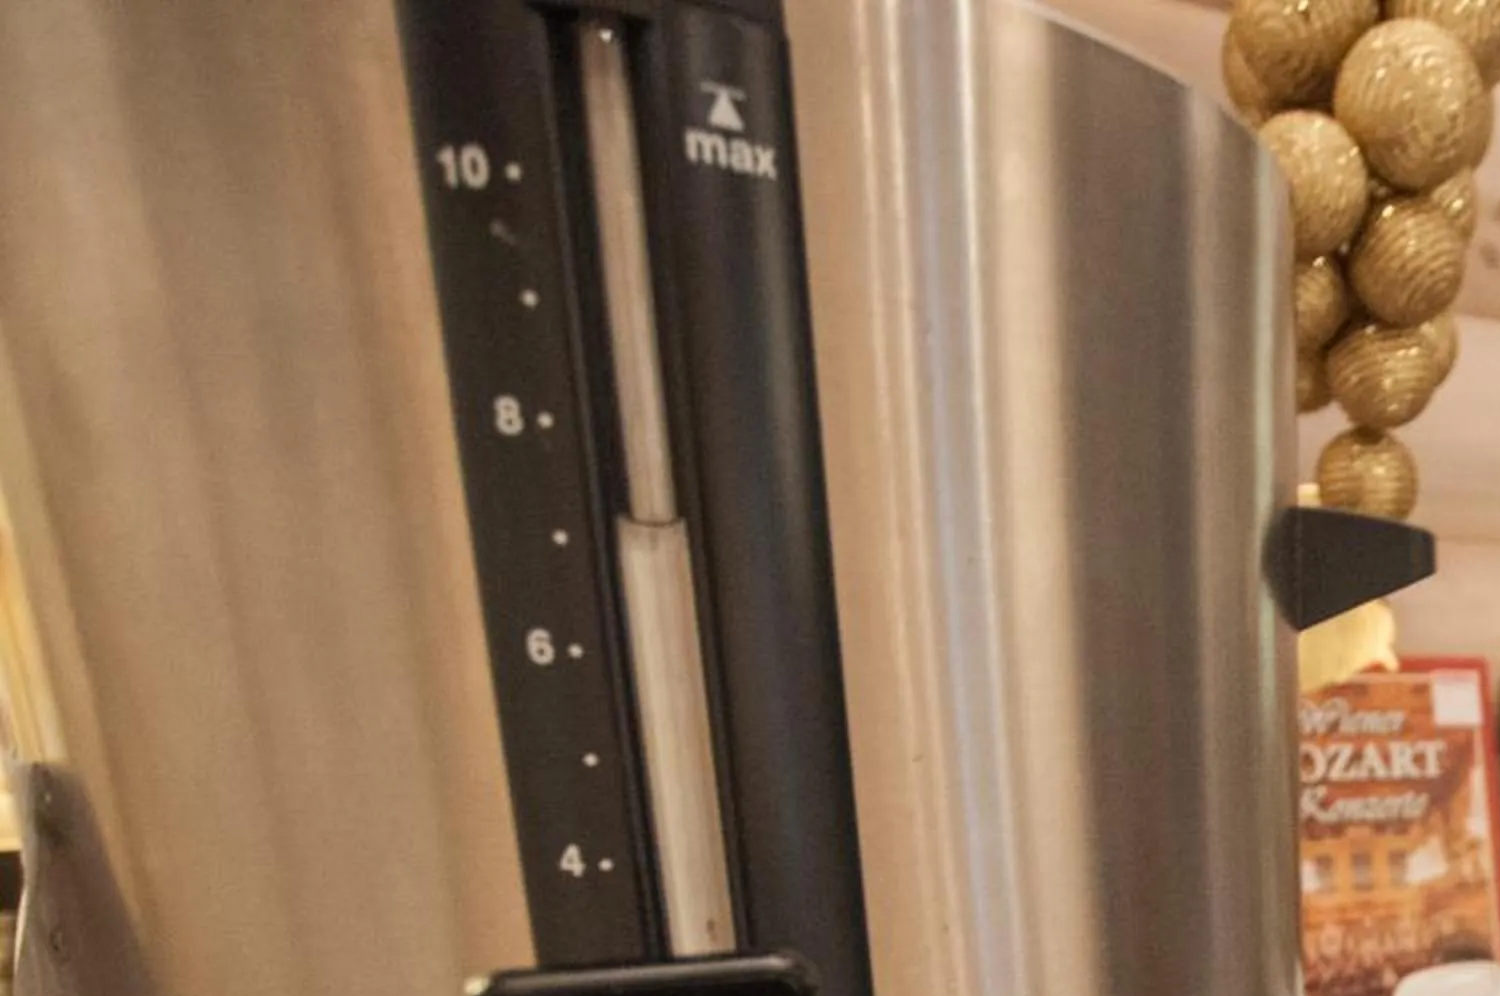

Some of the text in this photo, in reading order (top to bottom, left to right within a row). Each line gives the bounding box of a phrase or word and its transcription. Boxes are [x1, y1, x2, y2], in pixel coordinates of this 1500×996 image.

[437, 143, 490, 190] 10
[685, 129, 777, 179] max
[494, 393, 525, 436] 8
[525, 627, 556, 666] 6
[1299, 739, 1447, 782] OZART
[559, 843, 586, 878] 4
